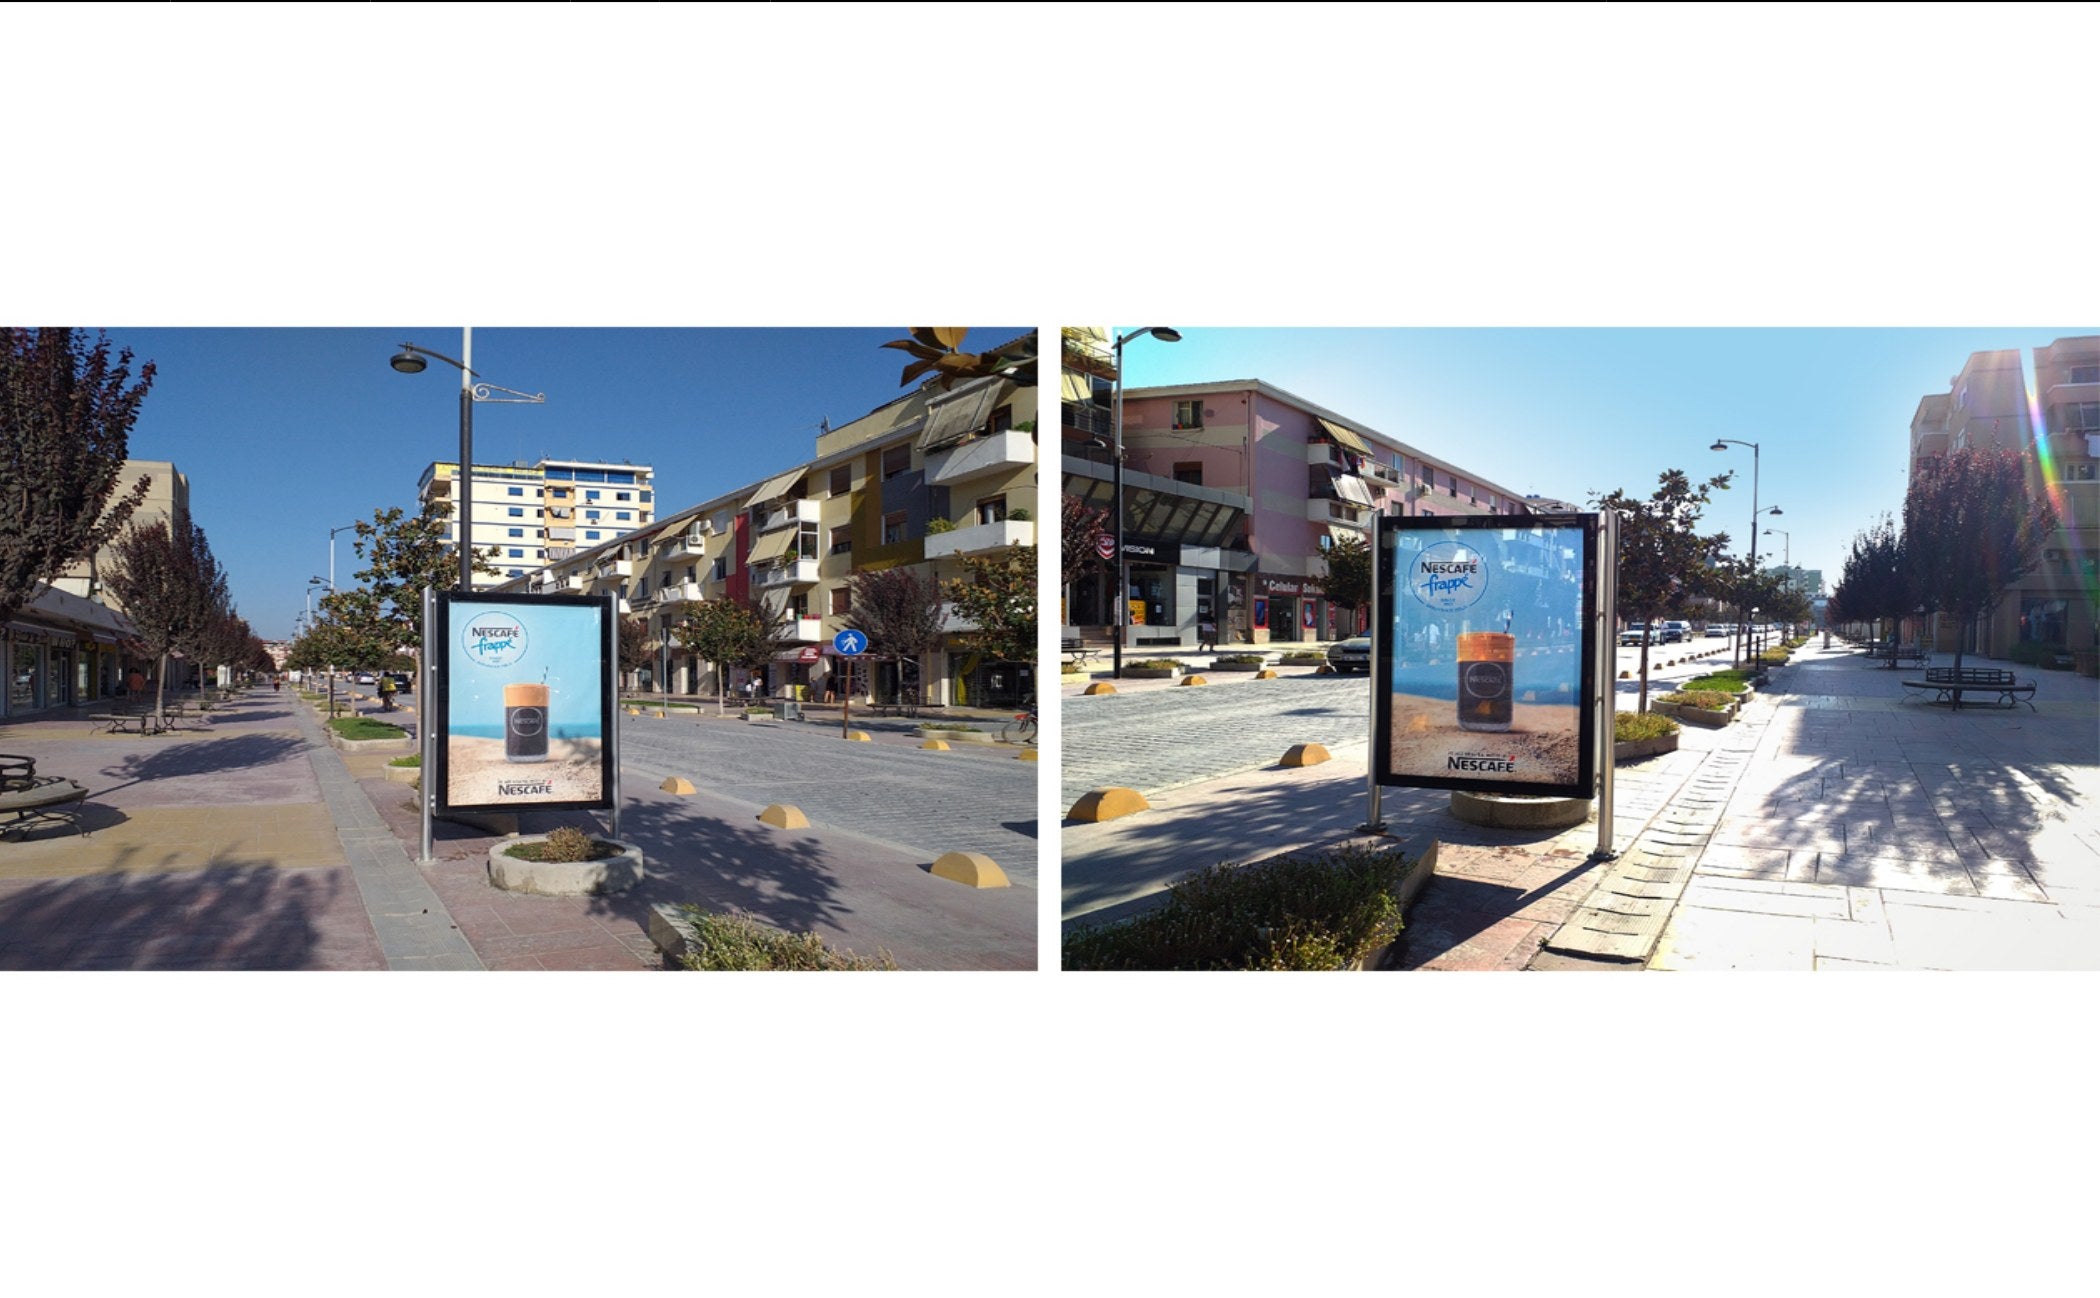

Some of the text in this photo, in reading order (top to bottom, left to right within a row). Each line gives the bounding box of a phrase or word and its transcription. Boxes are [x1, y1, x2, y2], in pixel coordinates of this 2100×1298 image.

[1421, 559, 1478, 574] NESCAFÉ
[1421, 573, 1473, 596] frappé
[472, 625, 519, 638] NESCAFÉ
[471, 636, 516, 655] frappé
[1447, 755, 1517, 773] NESCAFÉ
[499, 780, 553, 796] NESCAFÉ
